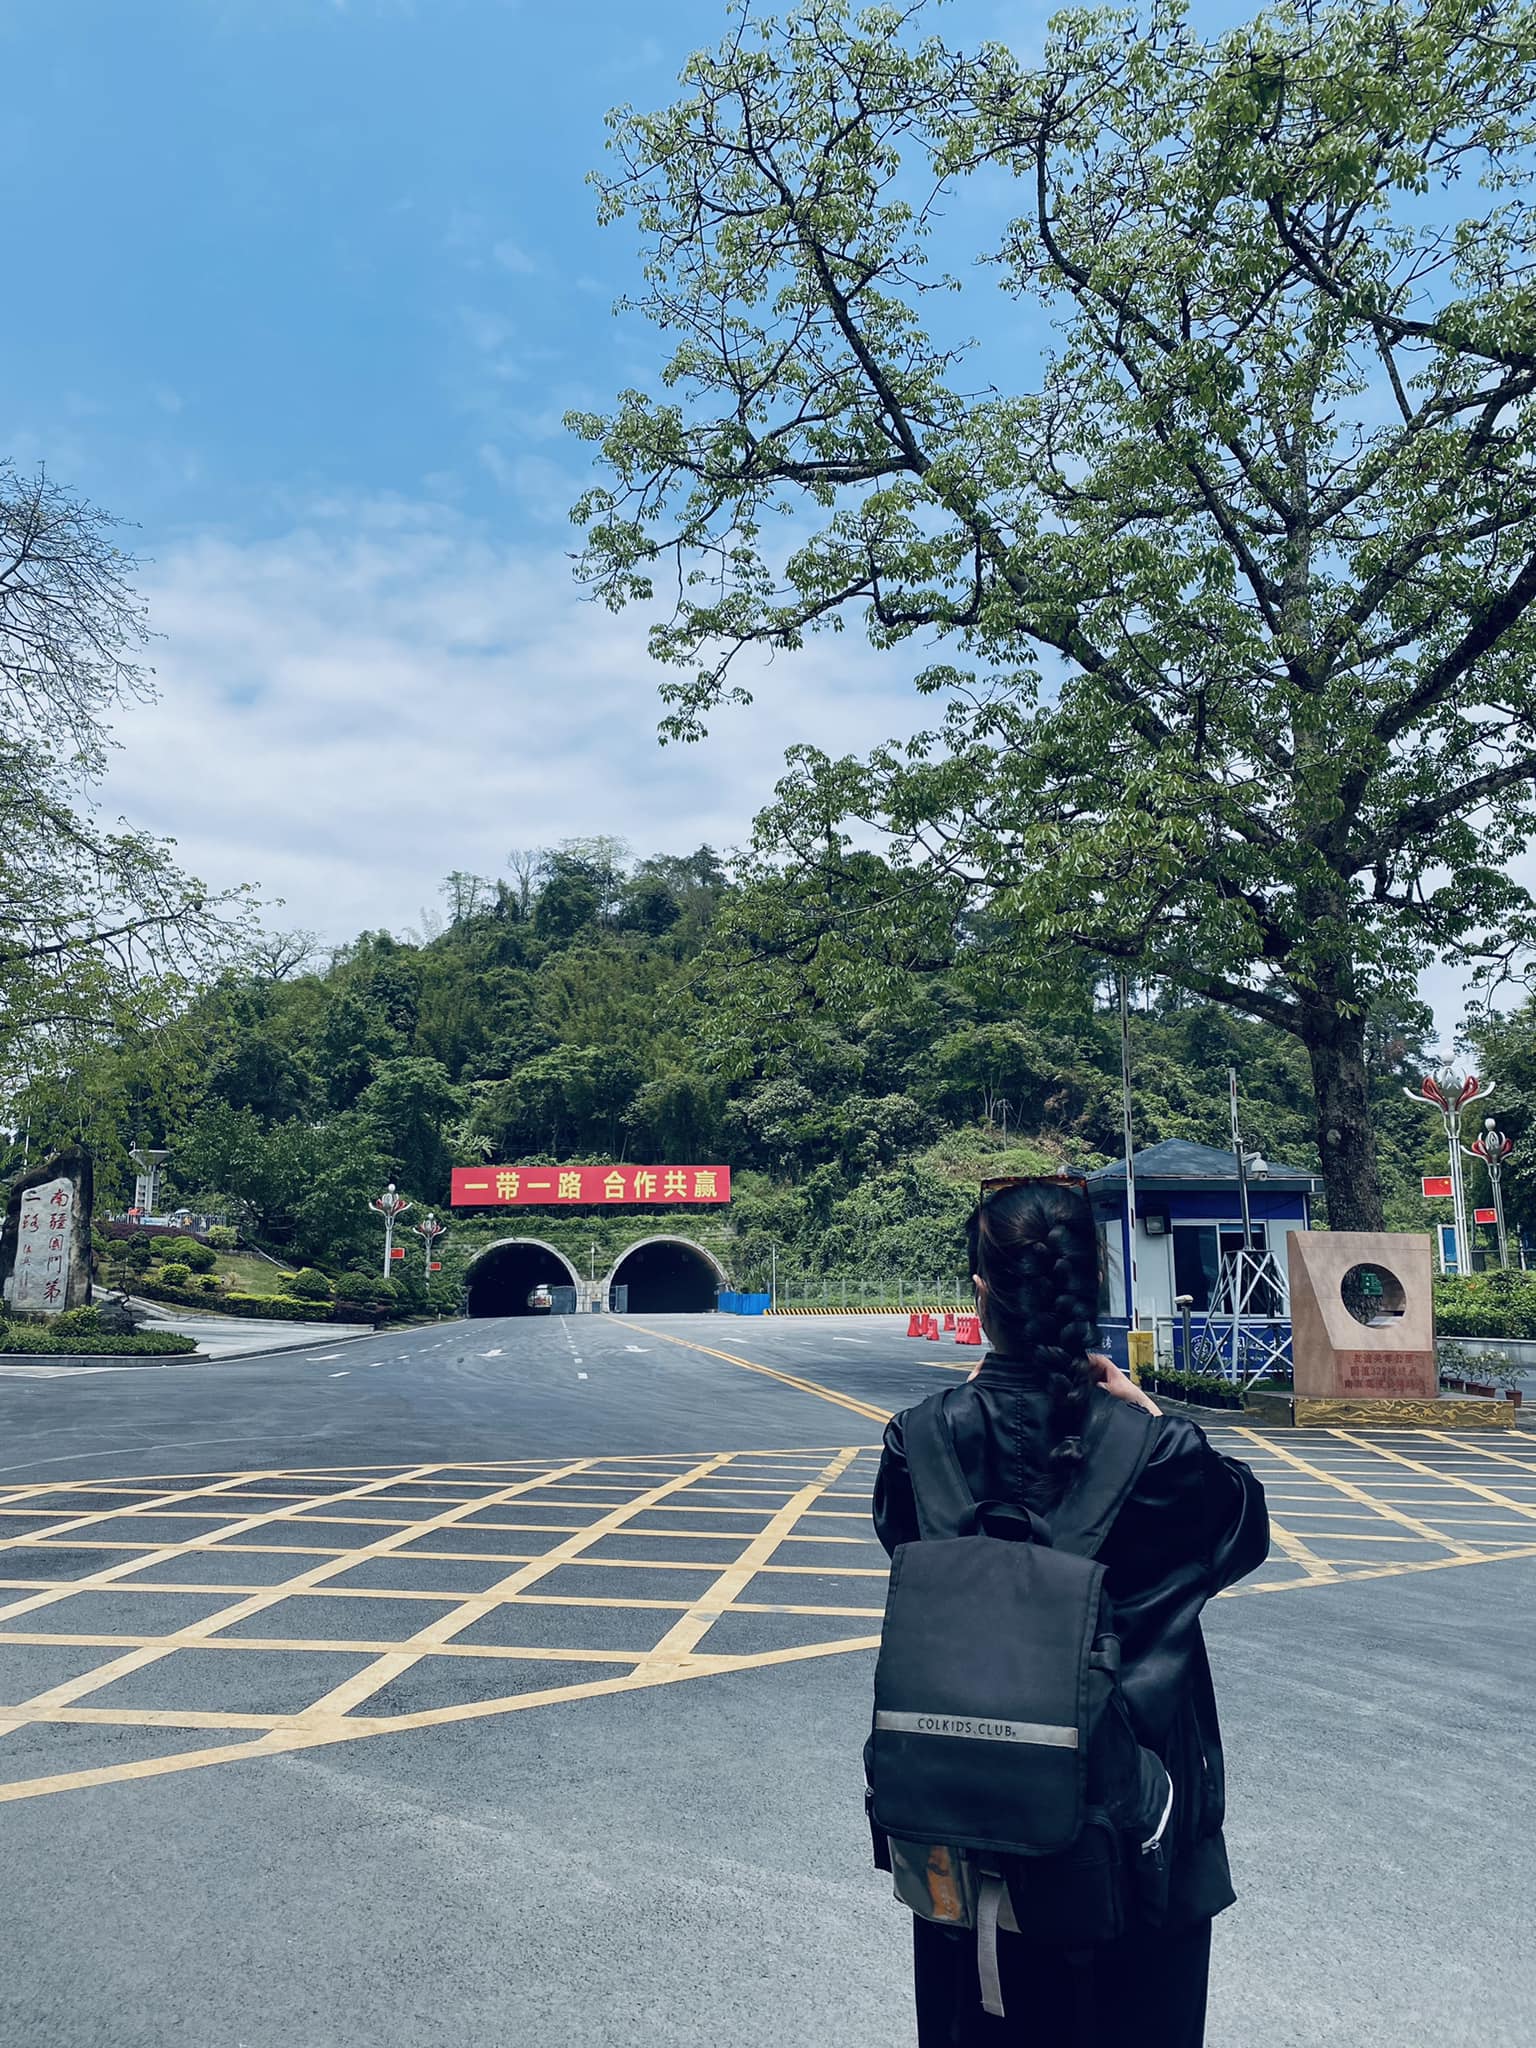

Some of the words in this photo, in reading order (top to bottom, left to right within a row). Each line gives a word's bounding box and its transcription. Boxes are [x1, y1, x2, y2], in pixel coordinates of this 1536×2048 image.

[464, 1172, 582, 1200] 一带一路
[603, 1171, 718, 1198] 合作共赢
